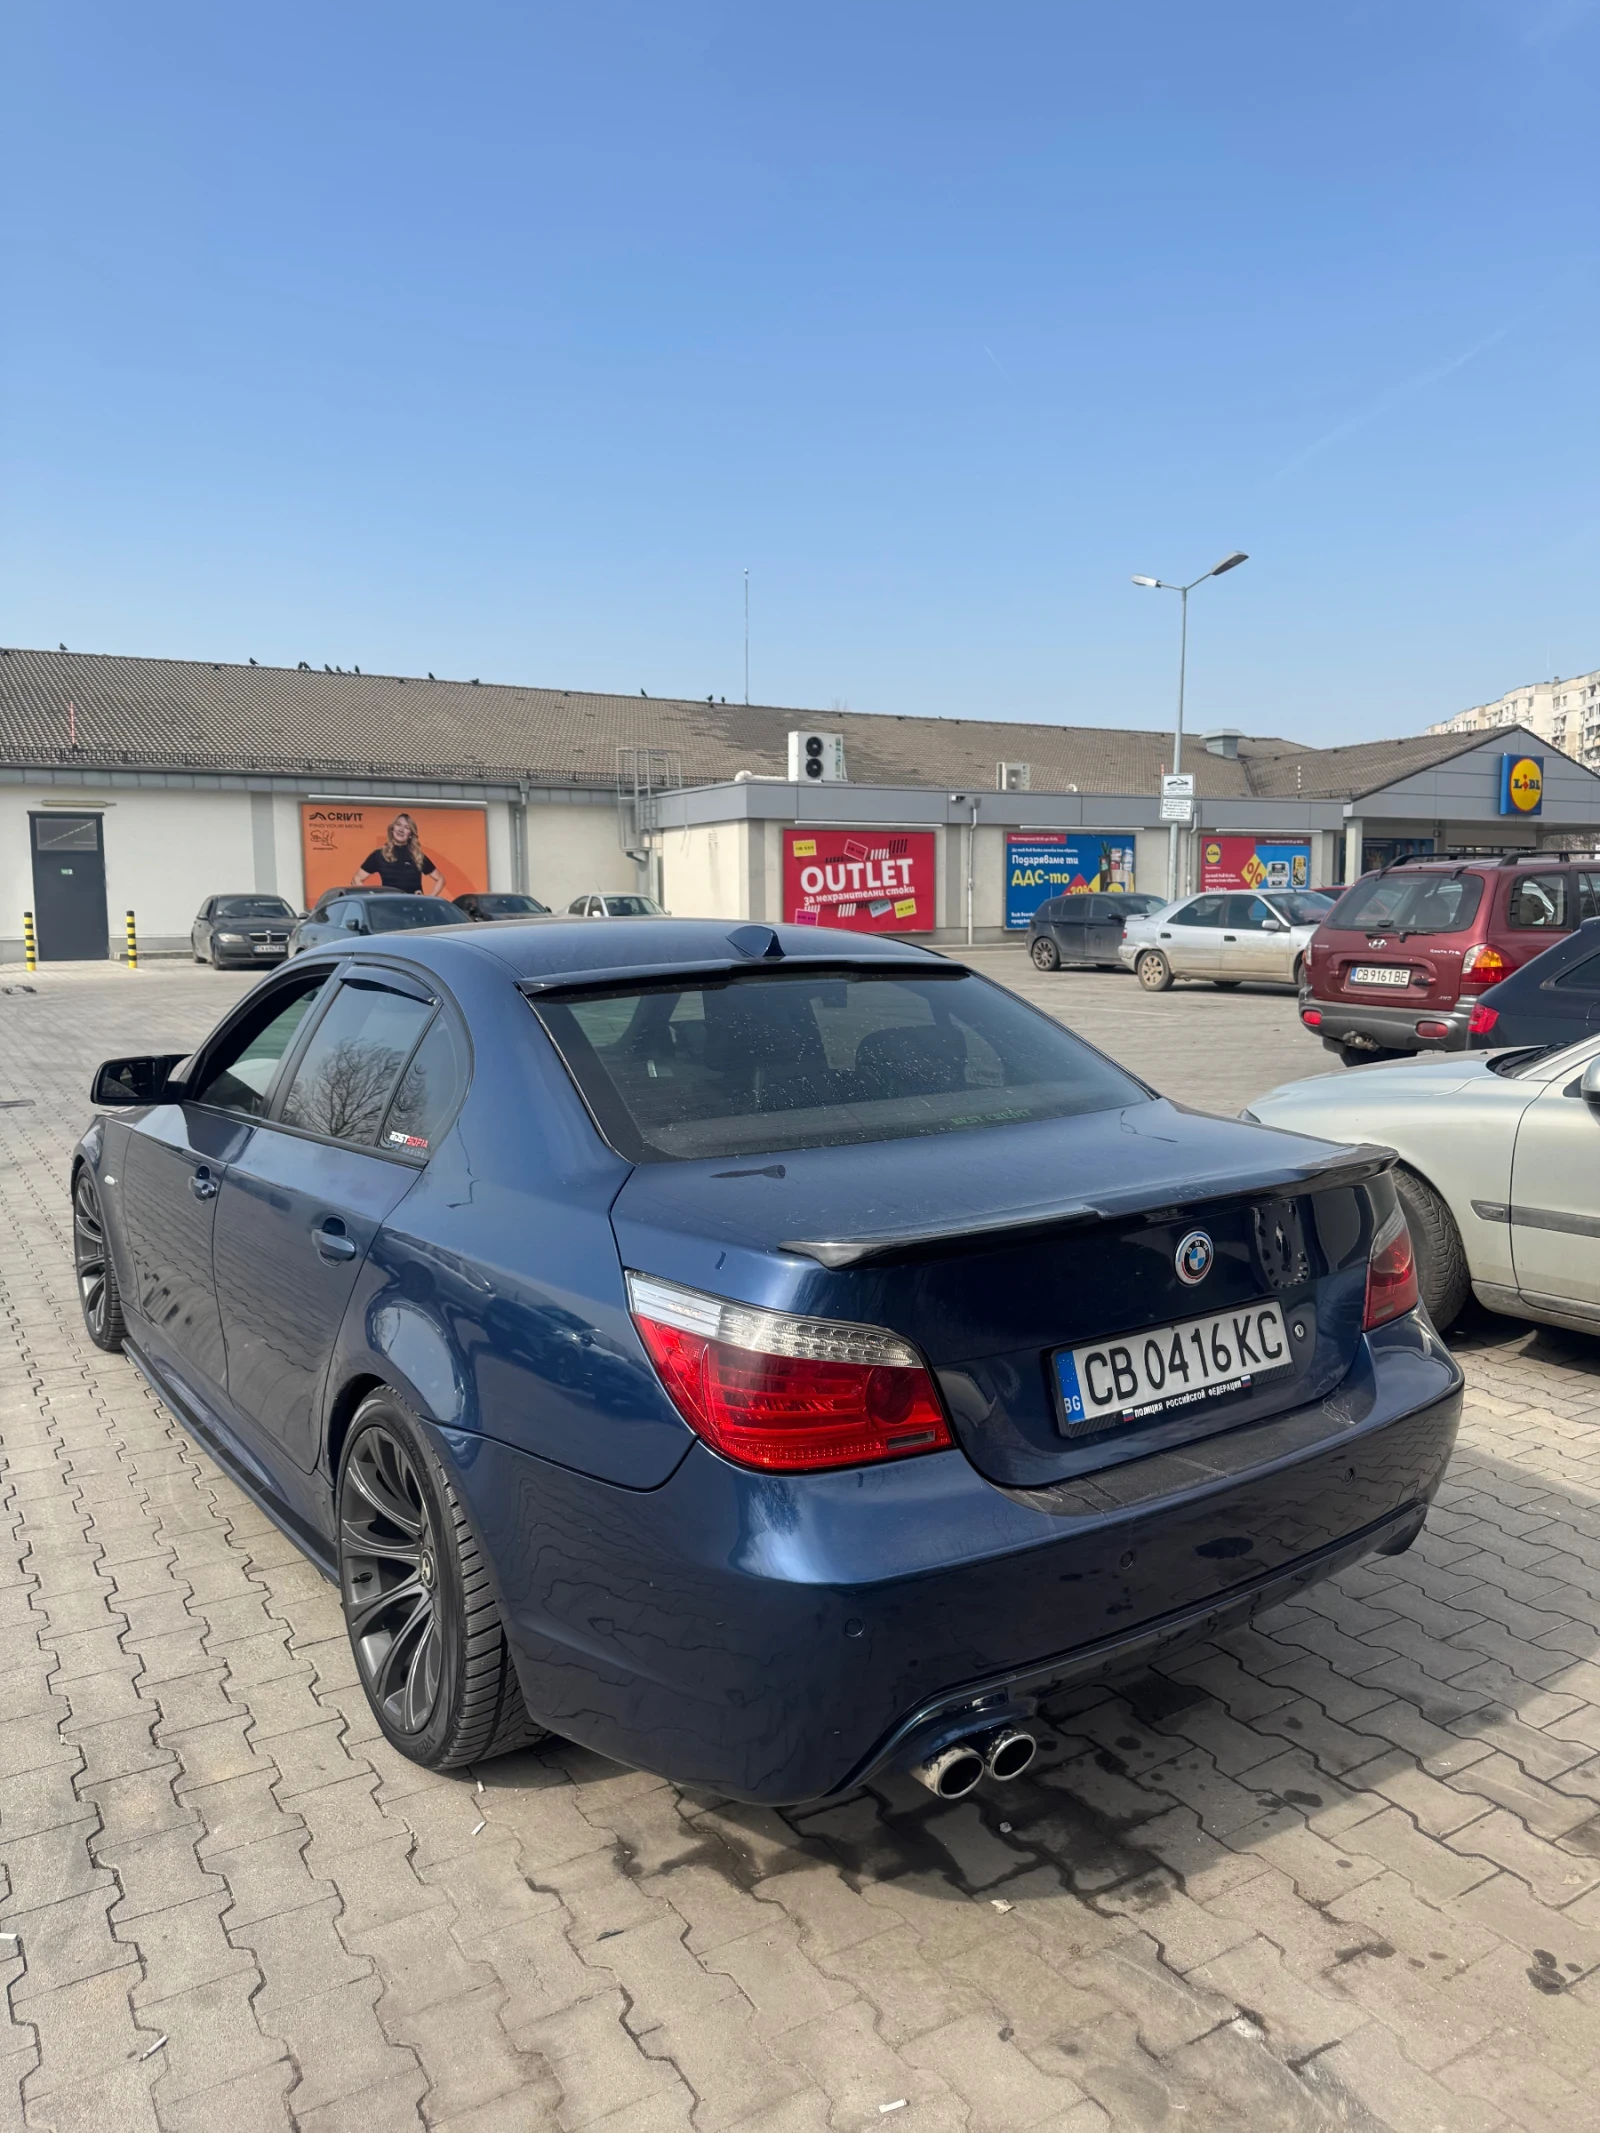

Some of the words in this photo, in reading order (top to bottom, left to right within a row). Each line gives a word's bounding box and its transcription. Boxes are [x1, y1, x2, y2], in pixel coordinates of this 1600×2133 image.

[327, 812, 364, 822] CRIVIT
[1011, 854, 1064, 867] Подаряваме
[1066, 857, 1079, 865] ти
[800, 858, 913, 894] OUTLET
[1011, 869, 1070, 887] ДДС-то
[803, 895, 814, 906] за
[816, 889, 884, 904] нехранителни
[886, 885, 915, 896] стоки
[1166, 1389, 1206, 1409] РОССИЙСКОЙ
[1208, 1380, 1242, 1397] ФЕДЕРАЦИИ
[1063, 1395, 1081, 1414] BG
